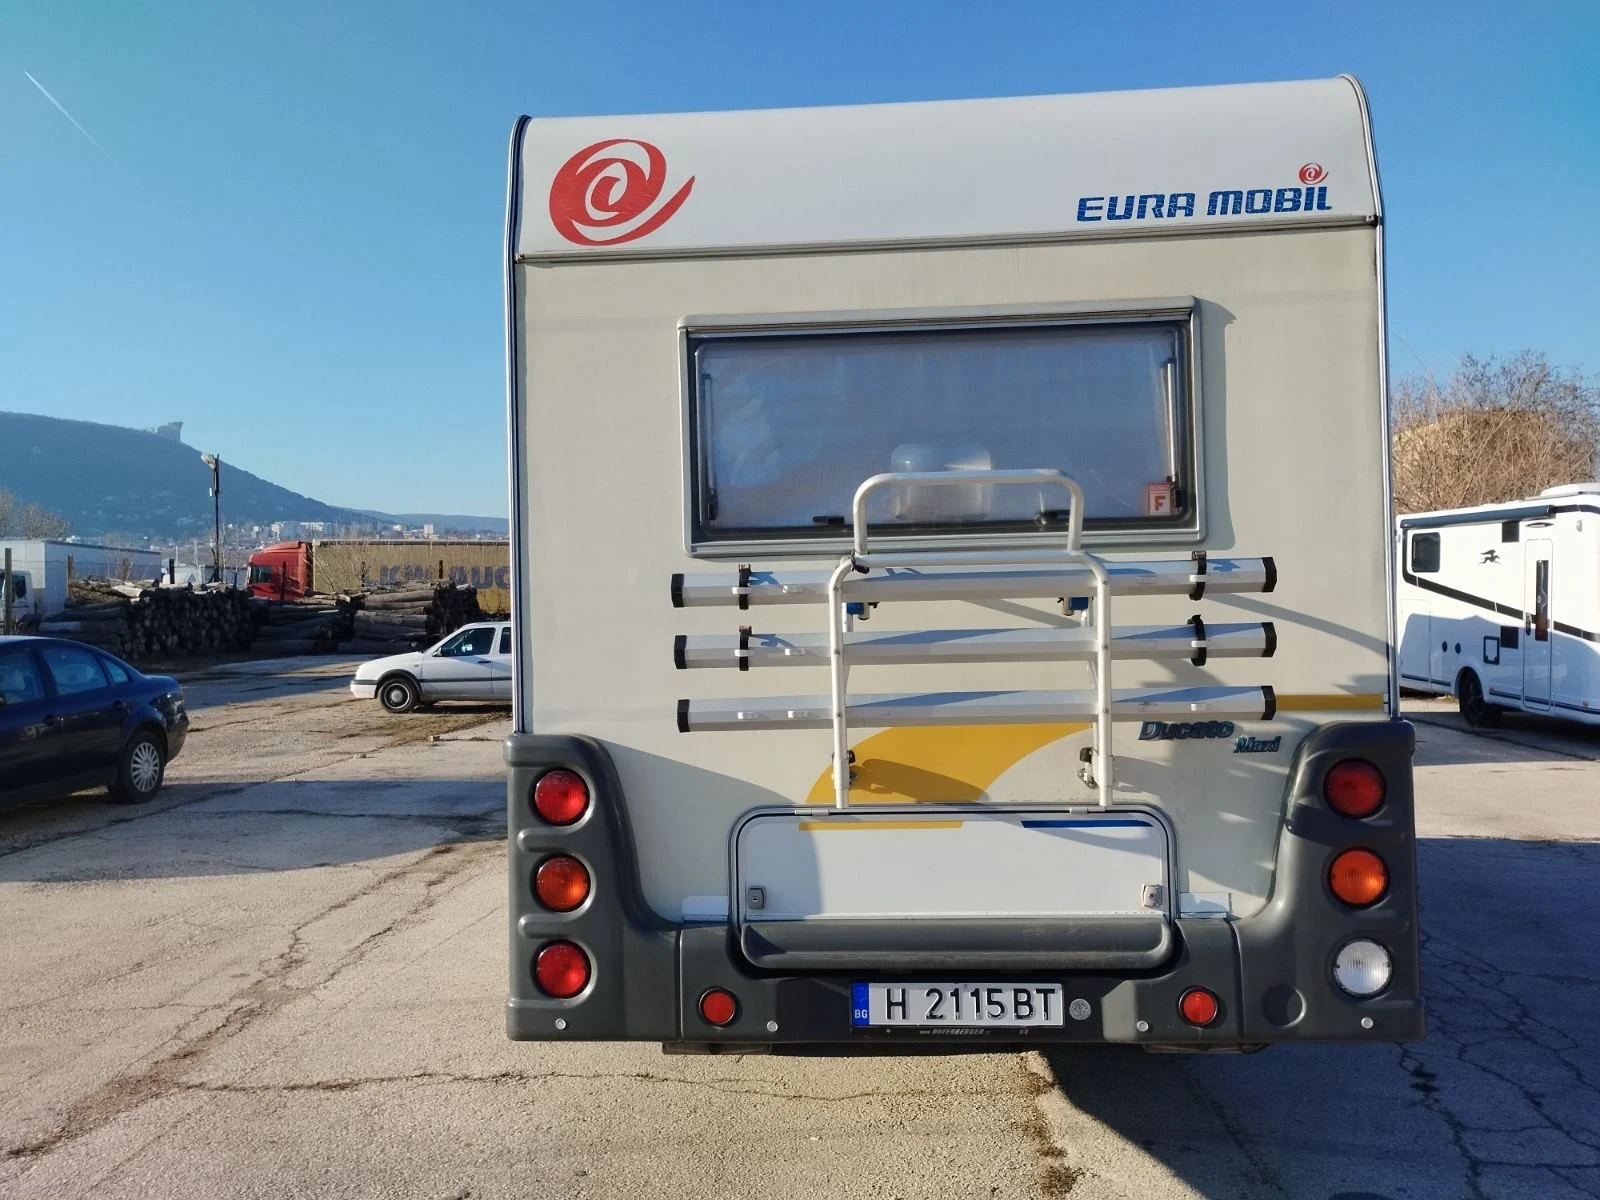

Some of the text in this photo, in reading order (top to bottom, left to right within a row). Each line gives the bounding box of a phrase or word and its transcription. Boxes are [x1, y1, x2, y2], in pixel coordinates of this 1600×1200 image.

[1076, 186, 1333, 222] EURA MOBIL
[1154, 495, 1166, 511] F
[1138, 720, 1234, 740] Ducato
[1233, 736, 1281, 753] Maxi
[885, 987, 907, 1020] H
[854, 1009, 868, 1019] BG
